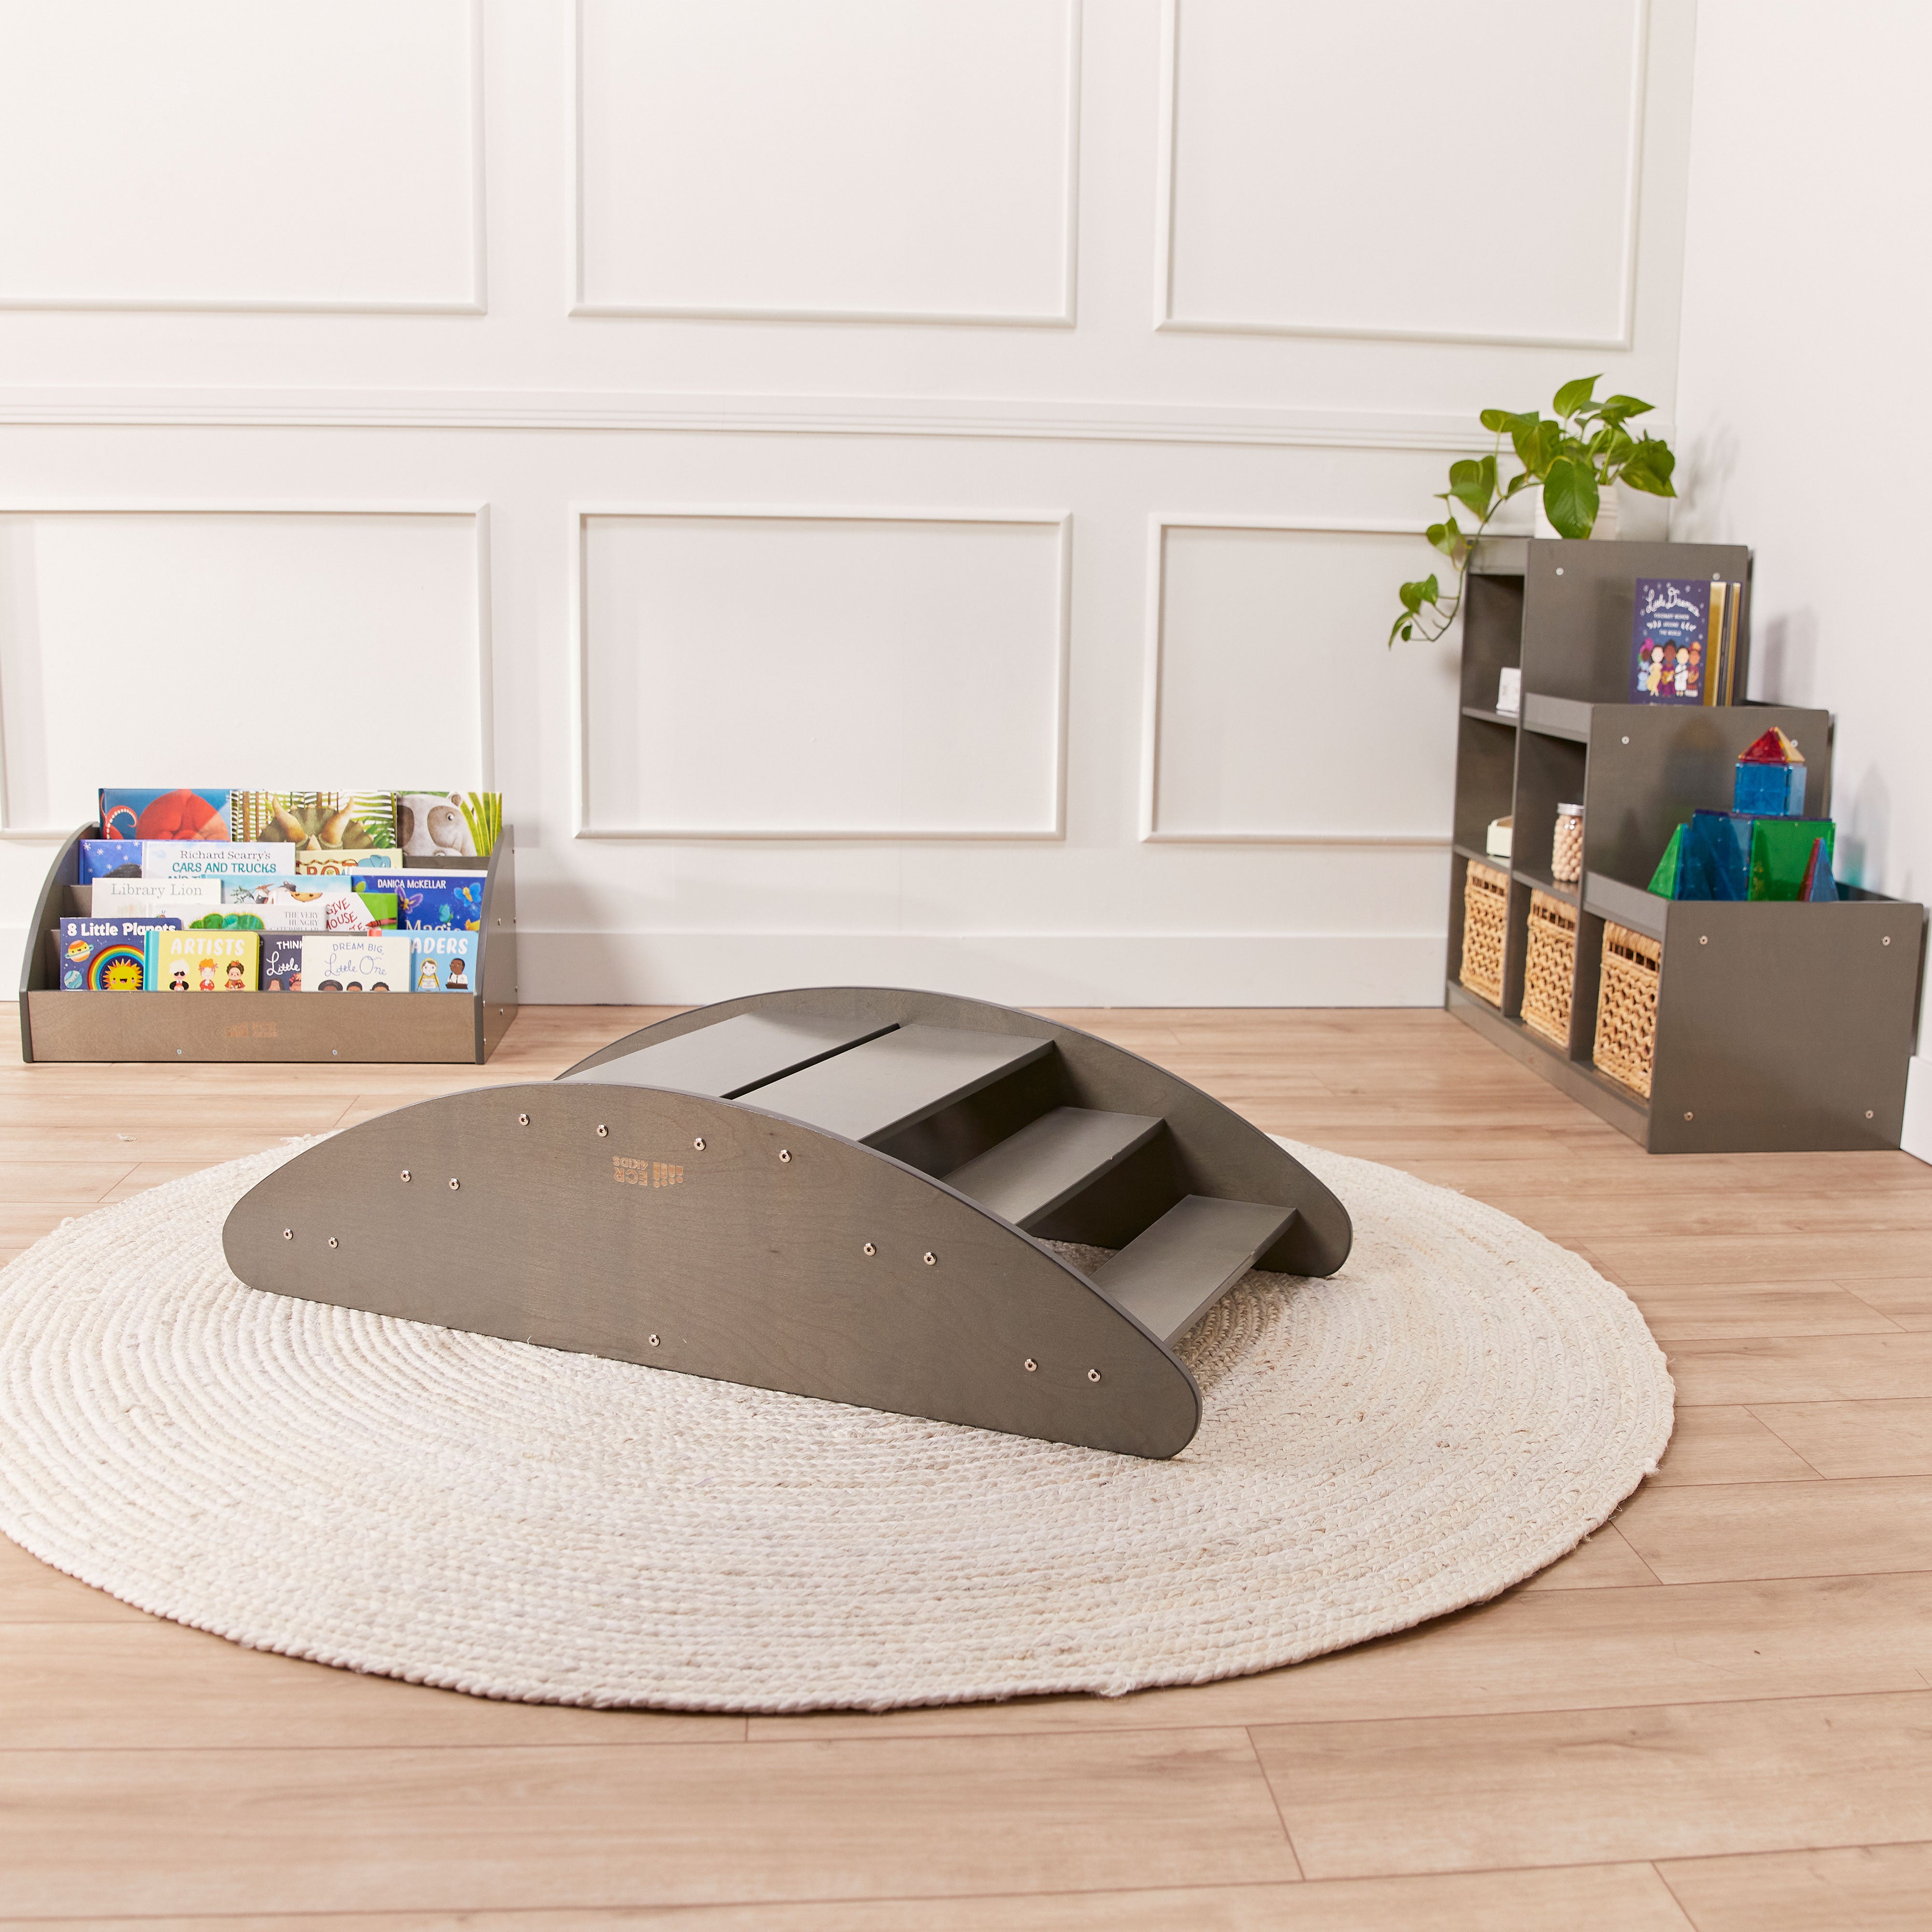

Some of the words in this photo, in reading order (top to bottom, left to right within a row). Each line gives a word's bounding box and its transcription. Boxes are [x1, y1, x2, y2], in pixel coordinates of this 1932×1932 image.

[180, 851, 224, 859] Richard
[227, 851, 270, 861] Scarry's
[172, 862, 202, 873] CARS
[204, 862, 227, 873] AND
[231, 863, 277, 873] TRUCKS
[111, 883, 166, 899] Library
[170, 883, 202, 896] Lion
[377, 879, 405, 889] DANICA
[407, 879, 446, 889] McKELLAR
[326, 898, 350, 915] GIVE
[67, 923, 77, 937] 8
[81, 922, 118, 937] Little
[170, 938, 245, 956] ARTISTS
[333, 942, 364, 952] DREAM
[368, 943, 384, 955] BIG,
[412, 937, 468, 954] ADERS
[266, 951, 301, 976] Little
[325, 952, 358, 977] Little
[359, 955, 387, 975] One
[612, 1156, 648, 1170] 4KIDS
[613, 1166, 648, 1186] ECR
